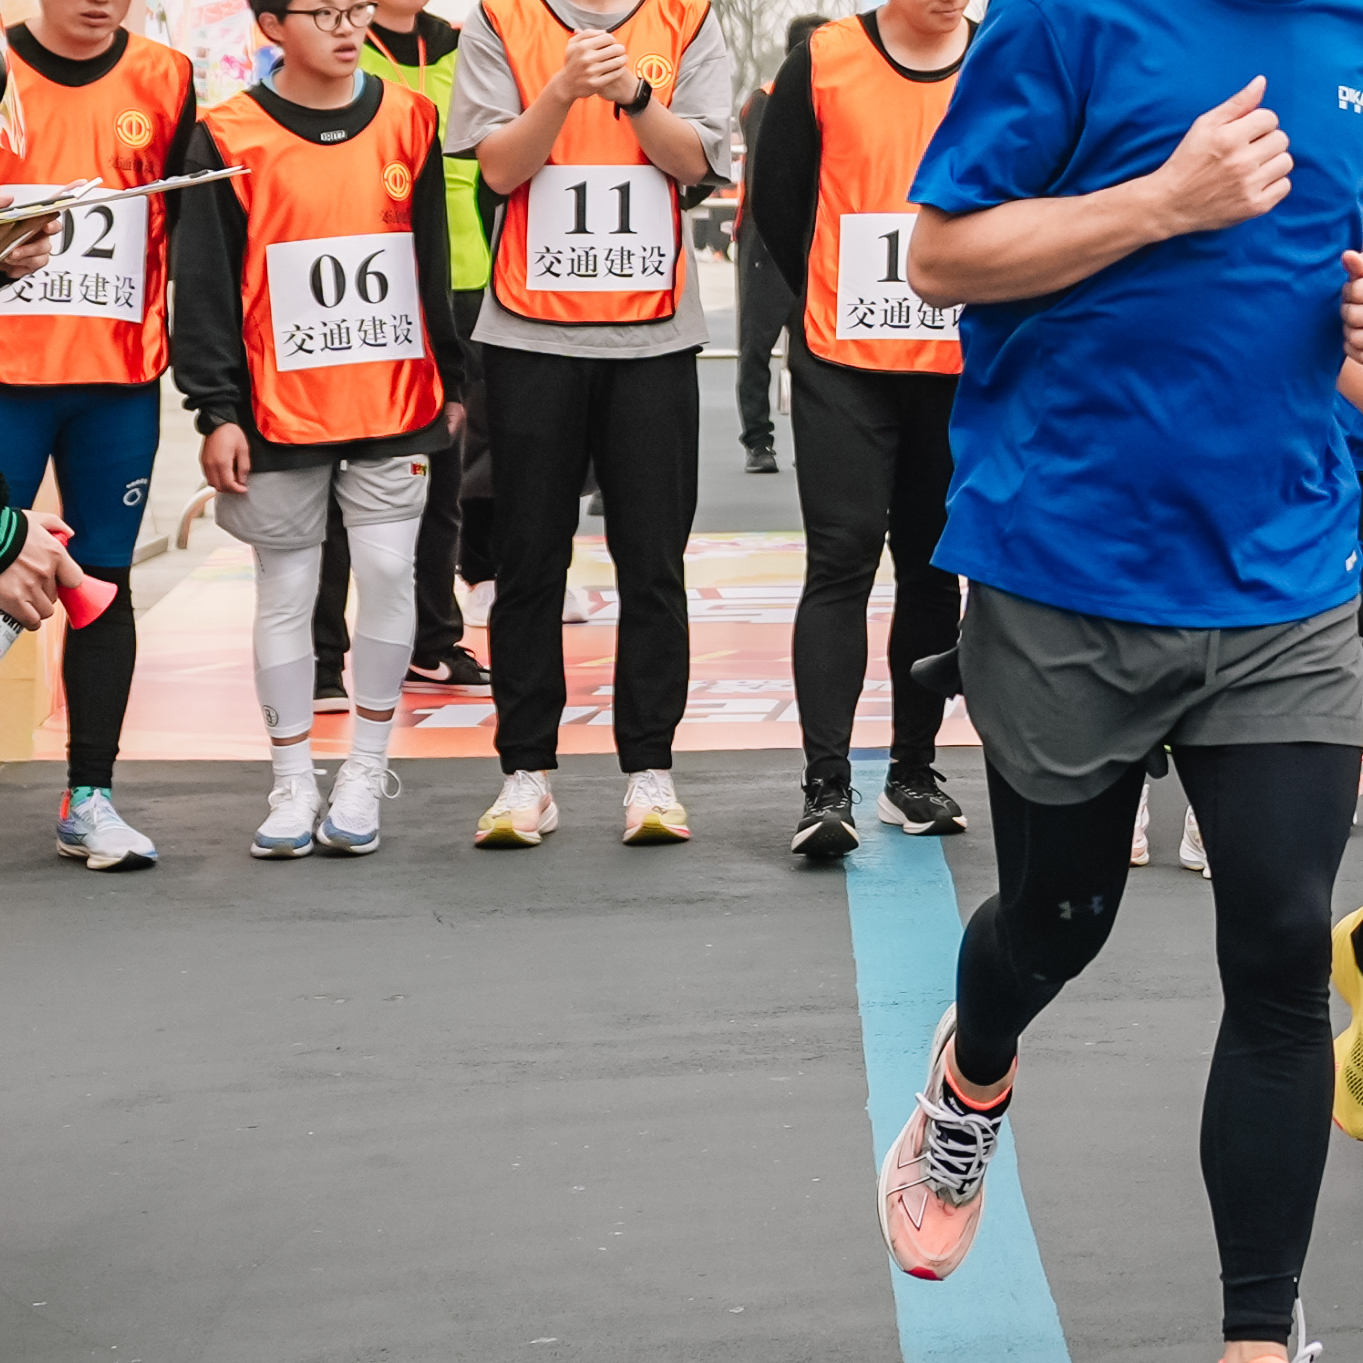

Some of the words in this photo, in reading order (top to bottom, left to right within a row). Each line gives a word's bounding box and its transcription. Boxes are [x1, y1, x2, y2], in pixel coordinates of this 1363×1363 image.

[564, 180, 638, 235] 11
[309, 248, 389, 309] 06
[533, 245, 668, 279] 交通建设
[2, 270, 136, 309] 交通建设
[281, 313, 414, 358] 交通建设
